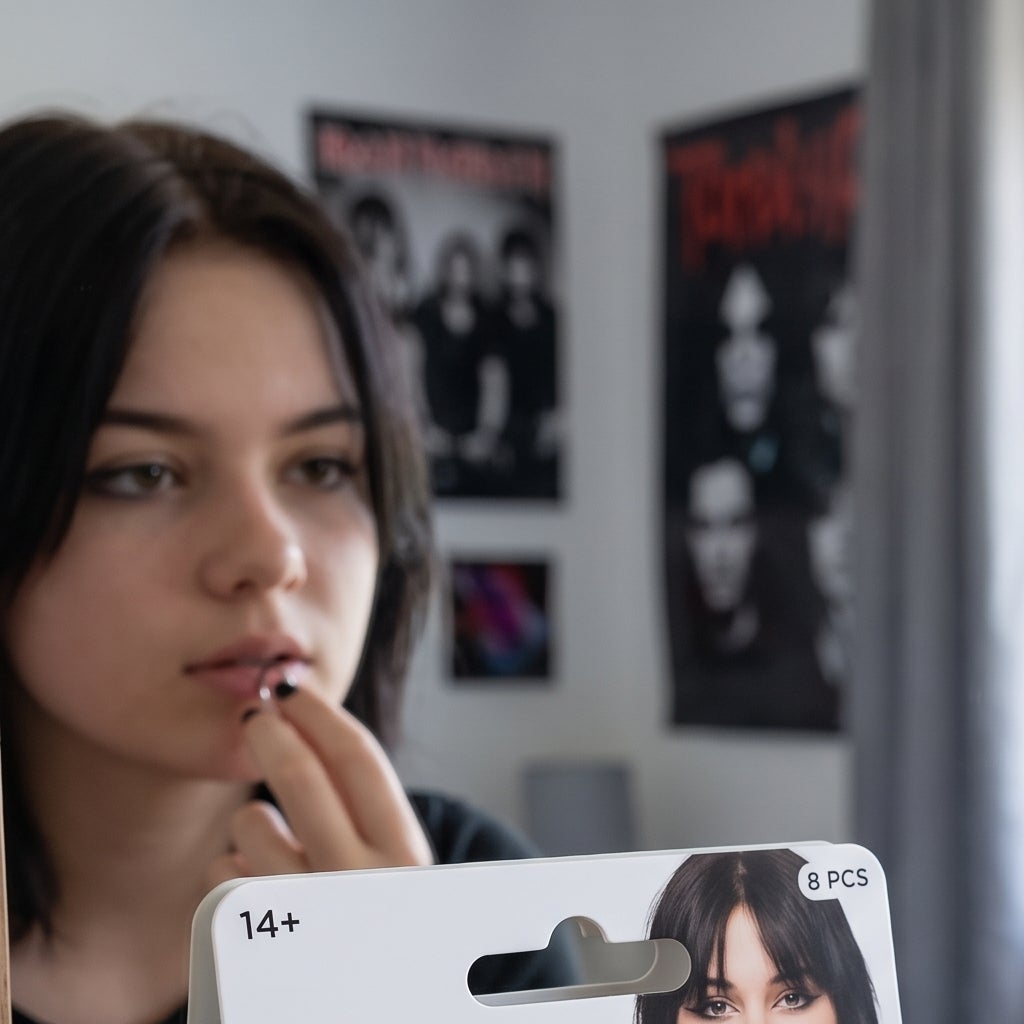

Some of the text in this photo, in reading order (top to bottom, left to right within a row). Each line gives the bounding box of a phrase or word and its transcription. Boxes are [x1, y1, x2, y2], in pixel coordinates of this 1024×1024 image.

[807, 868, 869, 891] 8 PCS
[239, 909, 300, 940] 14+
